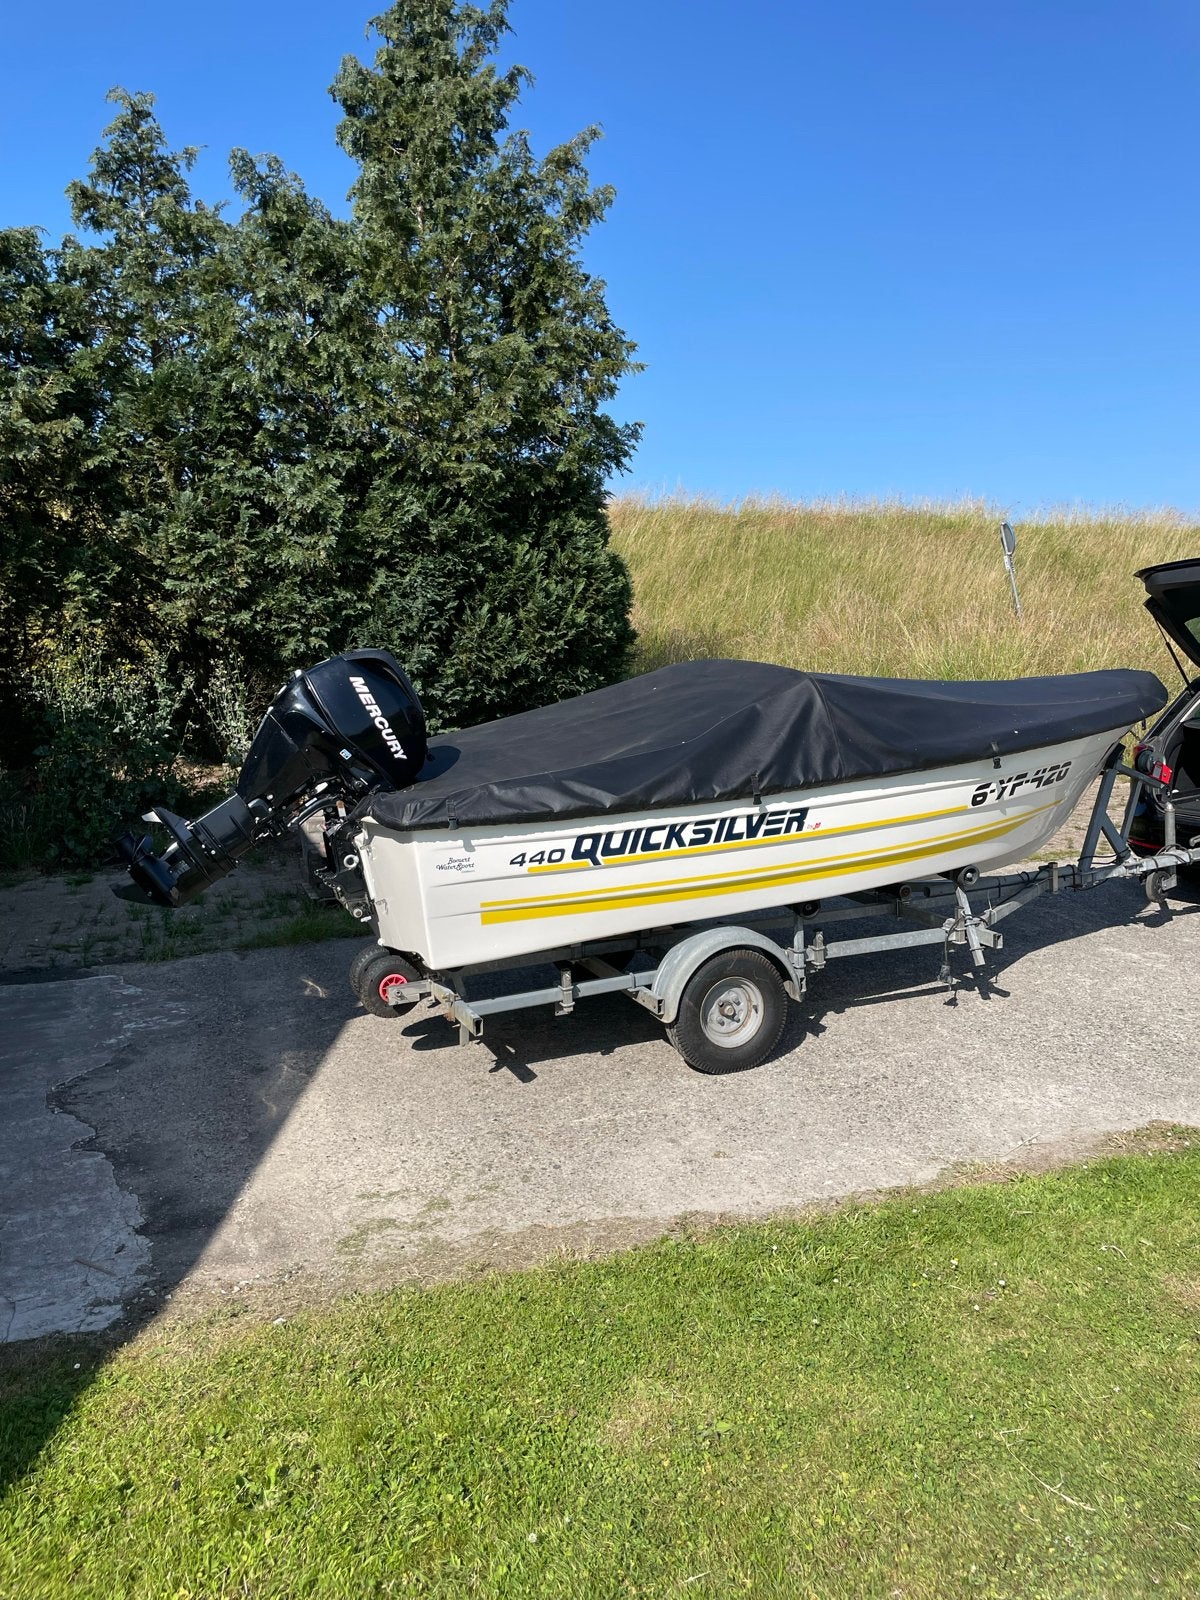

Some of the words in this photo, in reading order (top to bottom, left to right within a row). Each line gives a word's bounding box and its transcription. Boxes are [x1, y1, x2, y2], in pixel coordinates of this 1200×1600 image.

[349, 676, 407, 760] MERCURY
[971, 761, 1072, 806] 6-YF-420
[509, 848, 566, 866] 440
[571, 807, 810, 866] QUICKSILVER
